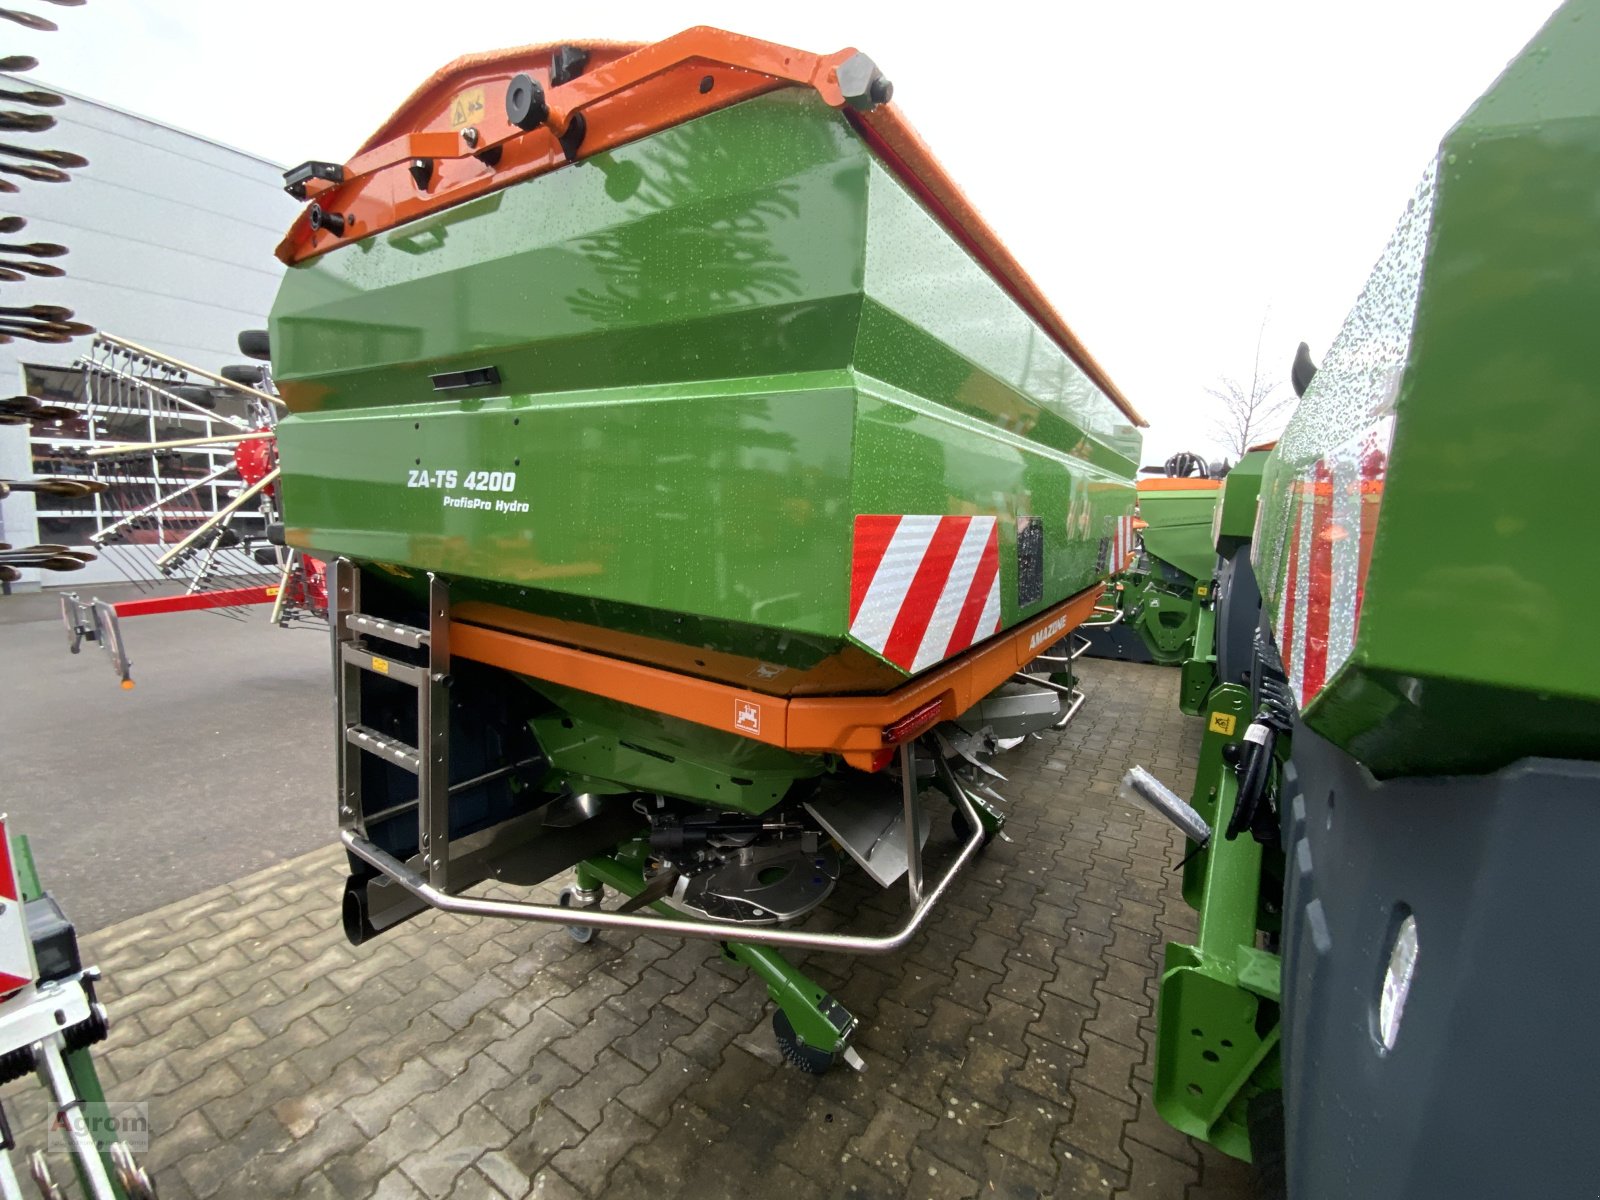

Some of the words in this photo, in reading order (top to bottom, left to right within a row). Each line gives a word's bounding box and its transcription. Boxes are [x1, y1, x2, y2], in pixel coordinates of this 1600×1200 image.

[407, 470, 458, 488] ZA-TS
[463, 471, 516, 492] 4200
[443, 496, 492, 510] ProfisPro
[495, 500, 530, 514] Hydro
[1029, 614, 1067, 651] AMAZONE
